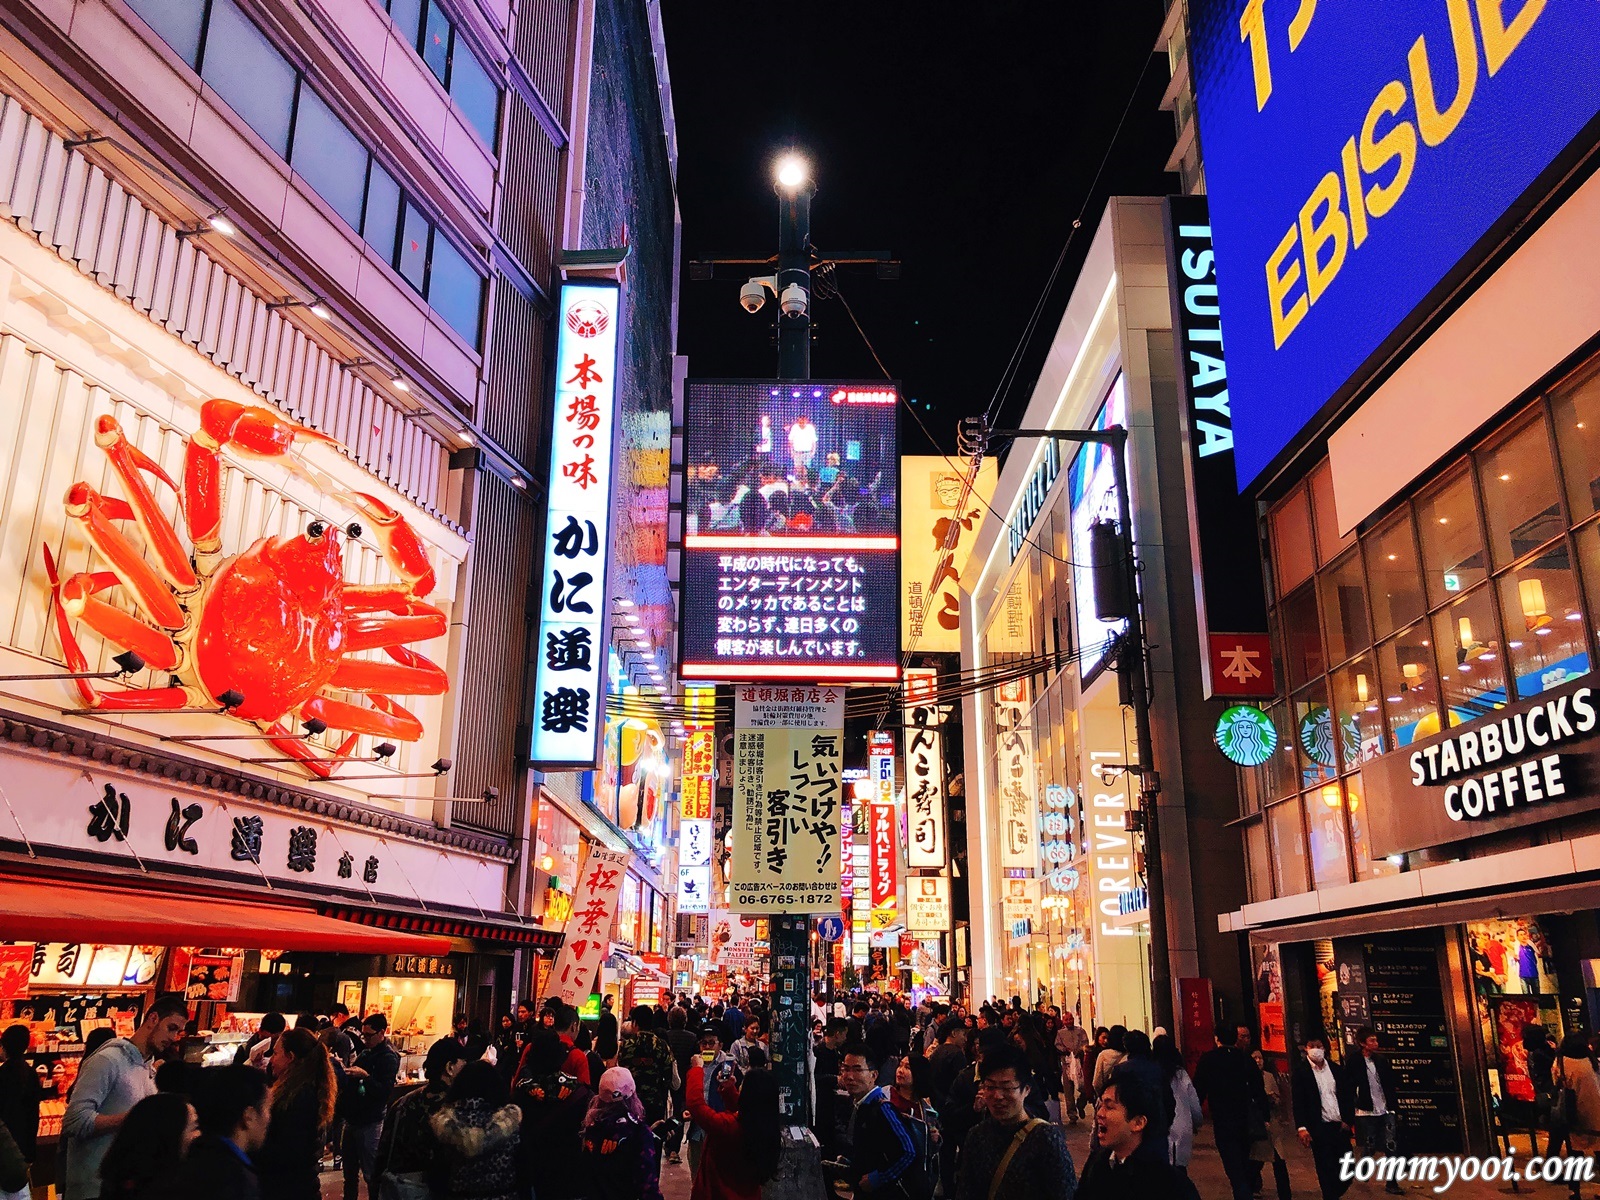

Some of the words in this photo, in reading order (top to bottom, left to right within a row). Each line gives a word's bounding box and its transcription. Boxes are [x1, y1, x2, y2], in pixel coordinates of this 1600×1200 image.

[562, 352, 603, 491] 本場の味
[718, 556, 865, 573] 平成の時代になっても、
[718, 576, 862, 593] エンターテインメント
[717, 617, 858, 633] 変わらず、連日多くの
[718, 596, 865, 612] のメッカであることは
[908, 581, 923, 637] 道頓堀店
[716, 639, 865, 656] 観客が楽しんでいます。
[1220, 645, 1262, 684] 本
[741, 687, 839, 704] 道頓堀商店会
[1409, 687, 1596, 787] STARBUCKS
[738, 733, 748, 796] 注意しましょう。
[1444, 754, 1566, 821] COFFEE
[790, 750, 811, 835] しつこい
[766, 789, 790, 874] 客引き
[875, 806, 891, 895] ツルハドラッグ
[734, 882, 838, 892] この広告スペースのお問い合わせは
[1093, 792, 1134, 937] FOREVER
[739, 894, 833, 904] 06-6765-1872
